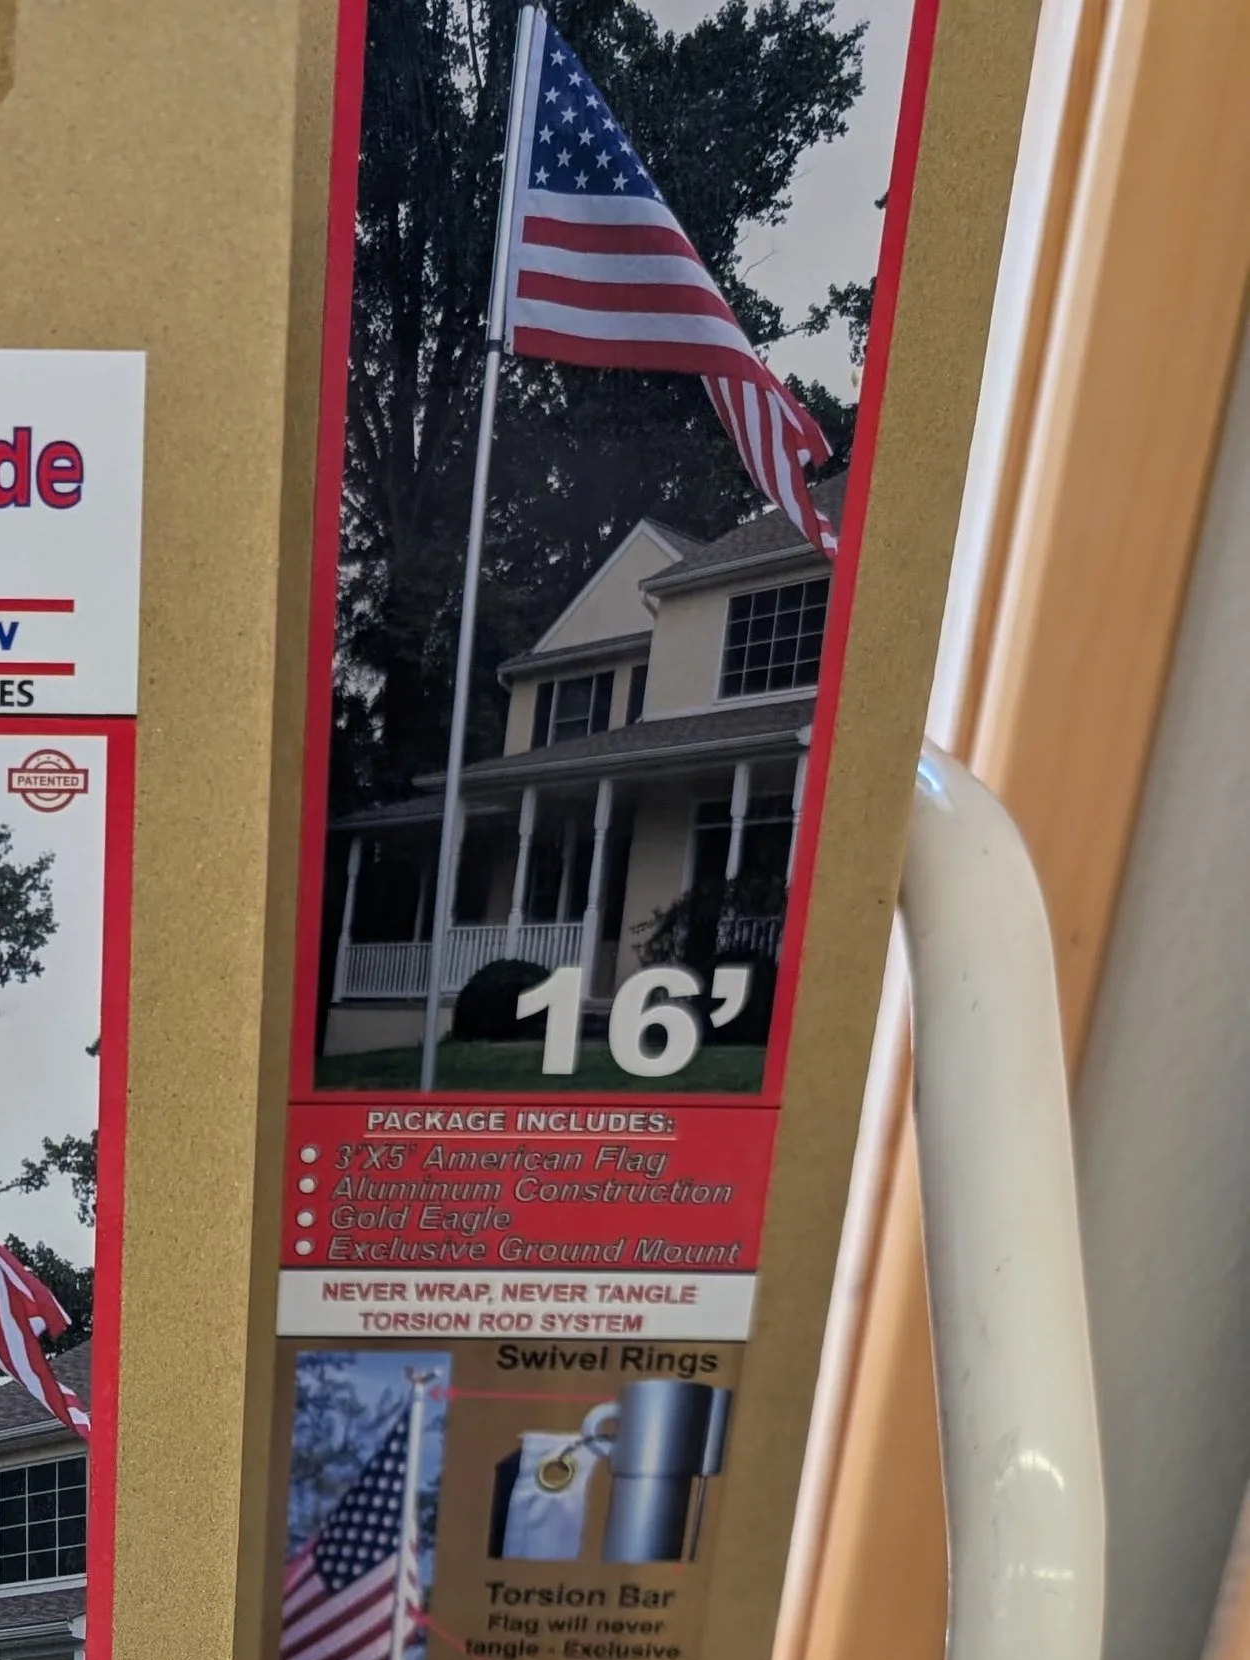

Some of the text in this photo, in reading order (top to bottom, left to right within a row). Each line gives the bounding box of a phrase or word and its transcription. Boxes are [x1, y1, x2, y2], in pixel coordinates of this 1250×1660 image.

[17, 776, 79, 786] PATENTED
[366, 1111, 675, 1134] PACKAGE INCLUDES:
[423, 1146, 582, 1172] American
[593, 1146, 669, 1179] Flag
[332, 1176, 733, 1204] Aluminum Construction
[331, 1205, 511, 1236] Gold Eagle
[326, 1236, 740, 1265] Exclusive Ground Mount
[322, 1282, 698, 1305] NEVER WRAP, NEVER TANGLE
[359, 1312, 643, 1333] TORSION ROD SYSTEM
[496, 1345, 718, 1375] Swivel Rings
[485, 1582, 676, 1608] Torsion Bar
[487, 1614, 665, 1636] Flag will never
[466, 1640, 539, 1660] tangle
[564, 1642, 682, 1660] Exclusive
